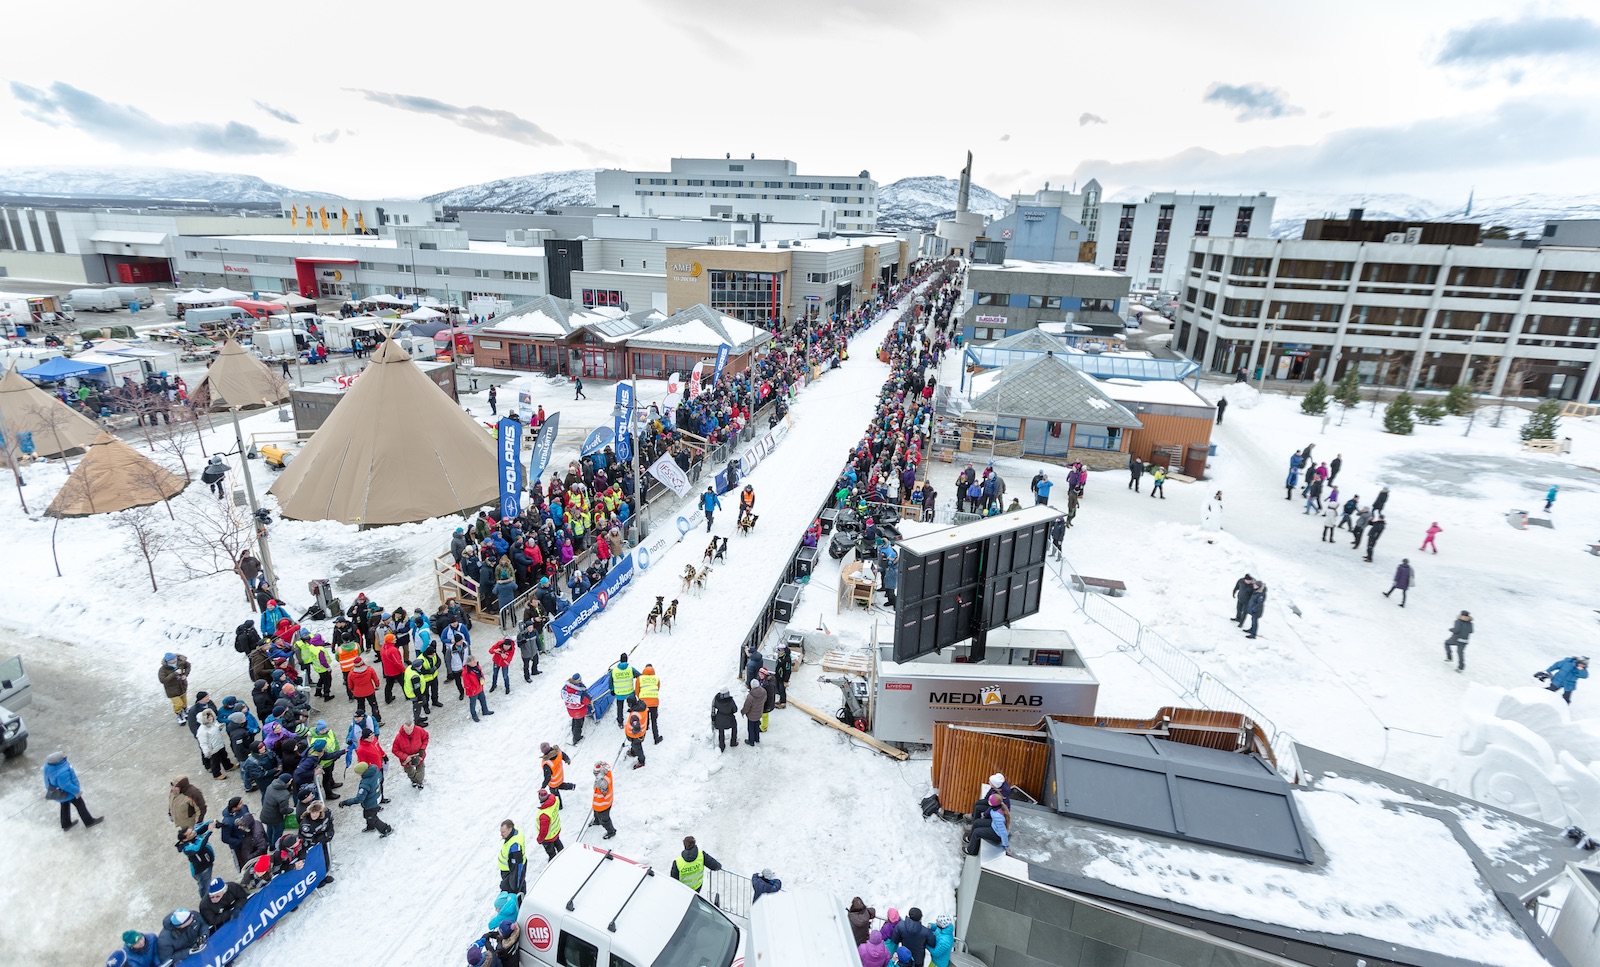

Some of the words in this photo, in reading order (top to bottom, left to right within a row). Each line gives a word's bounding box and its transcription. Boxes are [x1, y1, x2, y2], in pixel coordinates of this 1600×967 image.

[539, 426, 554, 470] SALTDALSHYTTA
[505, 425, 516, 494] POLARIS
[688, 510, 701, 522] north
[649, 538, 666, 554] north
[561, 601, 599, 637] SpareBank
[929, 690, 1043, 706] MEDIALAB
[681, 863, 701, 873] CREW
[529, 927, 549, 938] RIIS
